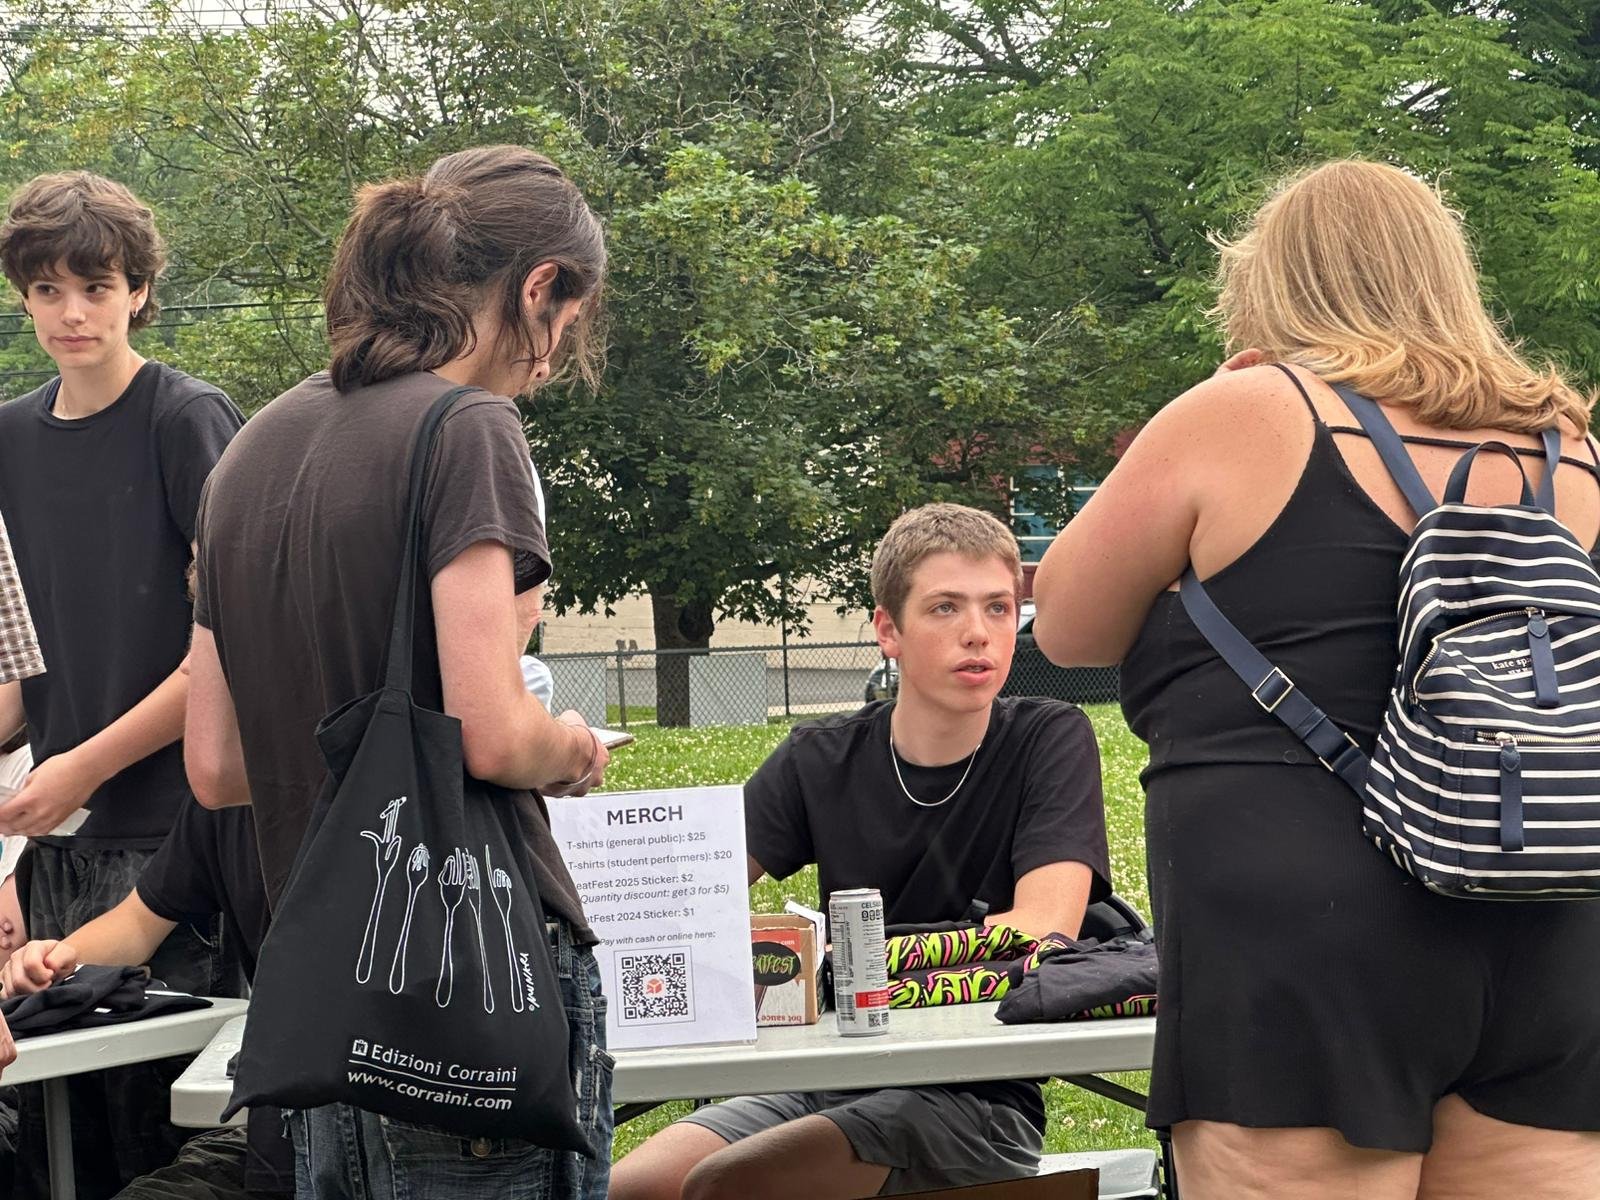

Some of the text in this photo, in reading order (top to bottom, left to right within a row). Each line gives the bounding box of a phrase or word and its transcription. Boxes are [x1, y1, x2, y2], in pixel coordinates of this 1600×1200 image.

[1491, 660, 1515, 670] kate
[606, 805, 684, 826] MERCH
[566, 831, 706, 851] T-shirts (general public): $25
[568, 850, 733, 871] T-shirts (student performers): $20
[576, 873, 694, 891] eatFest 2025 Sticker: $2
[580, 884, 730, 905] Quantity discount: get 3 for $5)
[617, 911, 641, 922] 2024
[643, 909, 681, 920] Sticker:
[682, 907, 695, 917] $1
[600, 938, 615, 948] Pay
[616, 937, 634, 945] with
[635, 934, 655, 944] cash
[667, 931, 693, 942] online
[694, 930, 716, 939] here:
[371, 1043, 517, 1083] Edizioni Corraini
[347, 1070, 512, 1111] www.corraini.com
